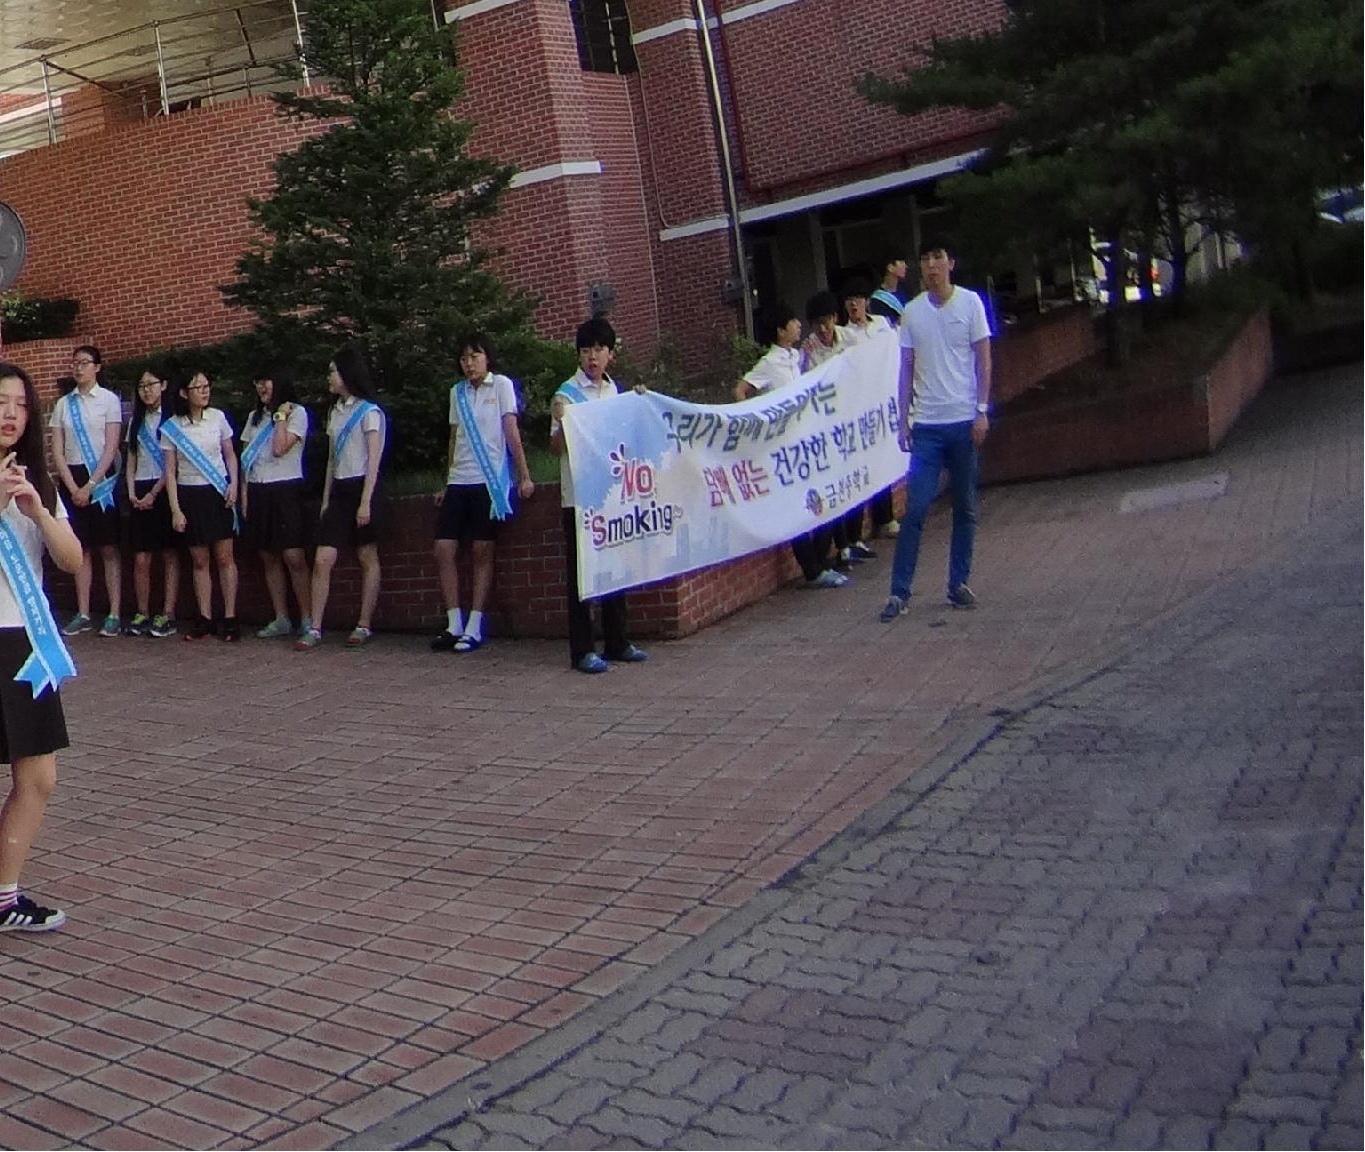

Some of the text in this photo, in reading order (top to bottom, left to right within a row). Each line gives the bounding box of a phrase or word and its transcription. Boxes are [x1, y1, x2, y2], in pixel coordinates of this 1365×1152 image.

[662, 410, 722, 453] 우리가
[619, 461, 656, 501] No
[731, 459, 771, 502] 없는
[771, 431, 831, 486] 건강한
[830, 422, 857, 462] 학교
[591, 502, 675, 549] Smoking
